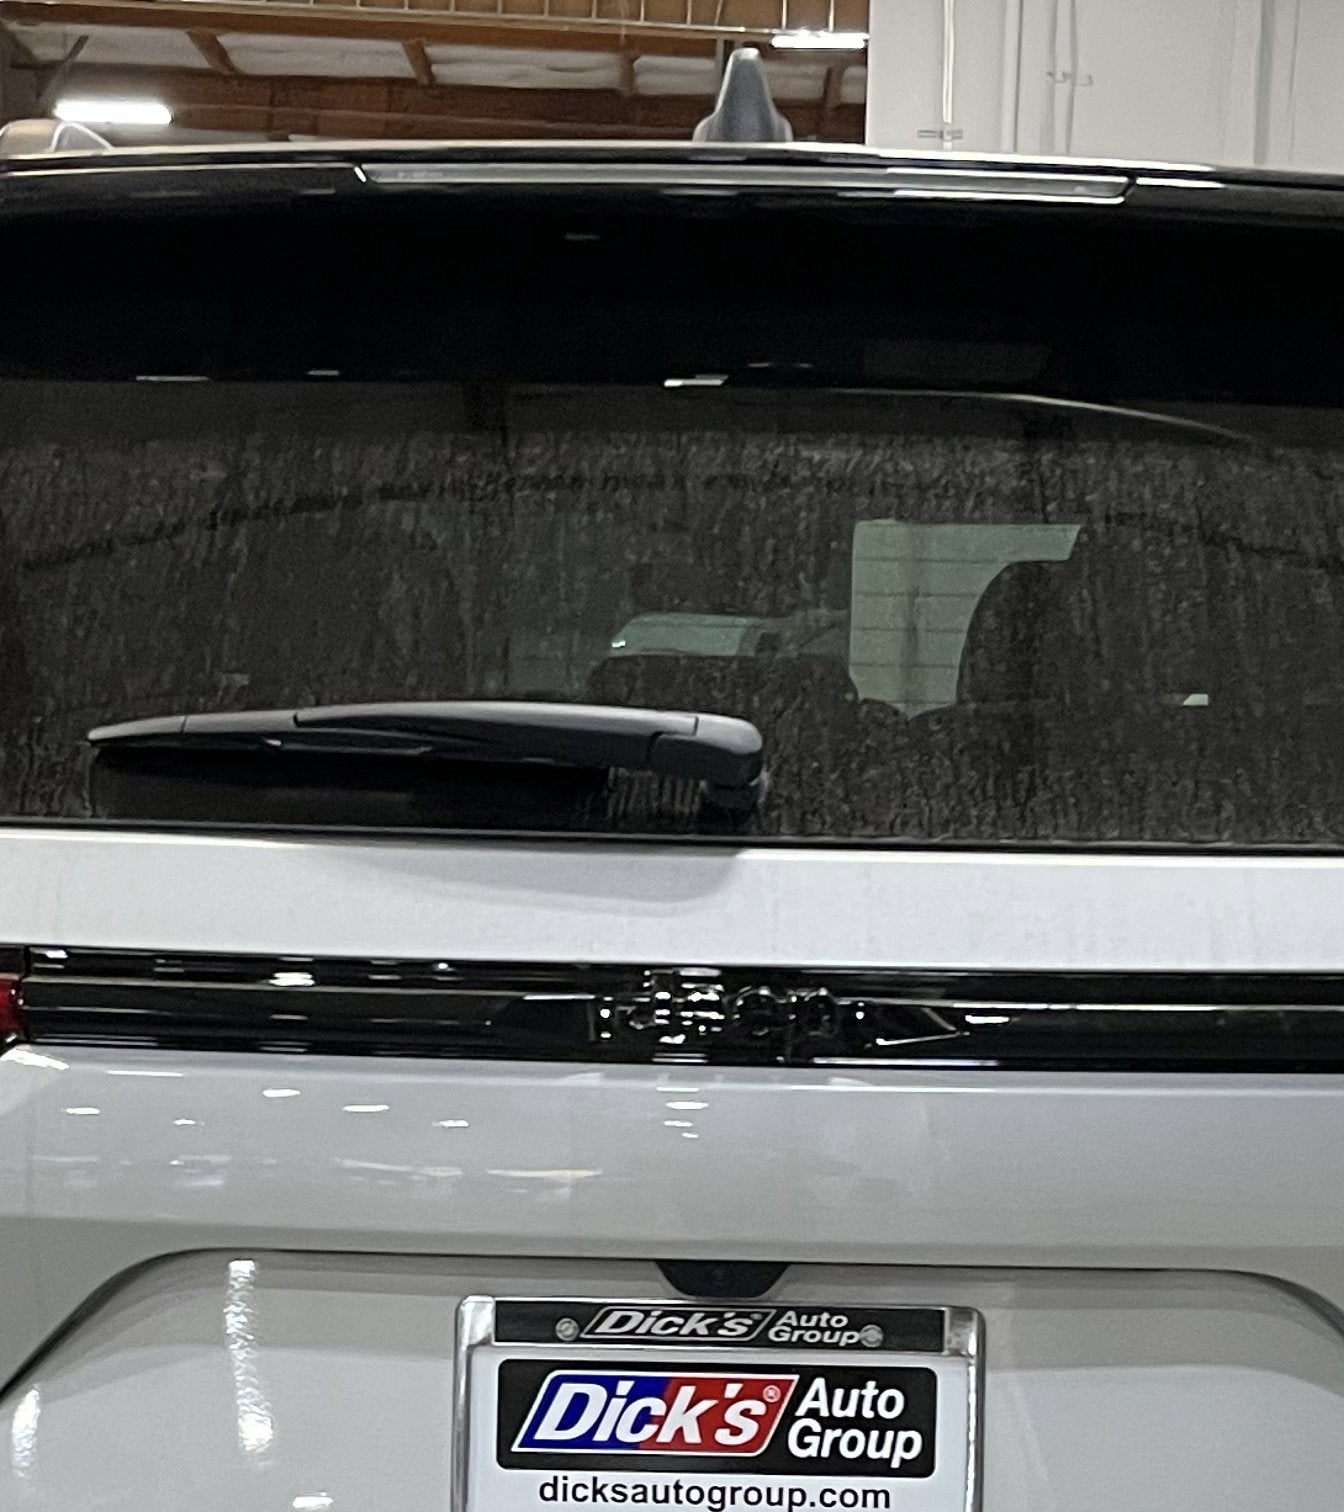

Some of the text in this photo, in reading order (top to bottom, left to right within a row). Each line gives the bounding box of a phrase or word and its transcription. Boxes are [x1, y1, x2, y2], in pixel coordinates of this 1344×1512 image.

[594, 1310, 754, 1337] Dick's
[777, 1309, 849, 1328] Auto
[767, 1327, 860, 1347] Group
[533, 1379, 766, 1447] Dick's
[794, 1377, 905, 1420] Auto
[787, 1419, 922, 1469] Group
[538, 1476, 891, 1512] dicksautogroup.com
